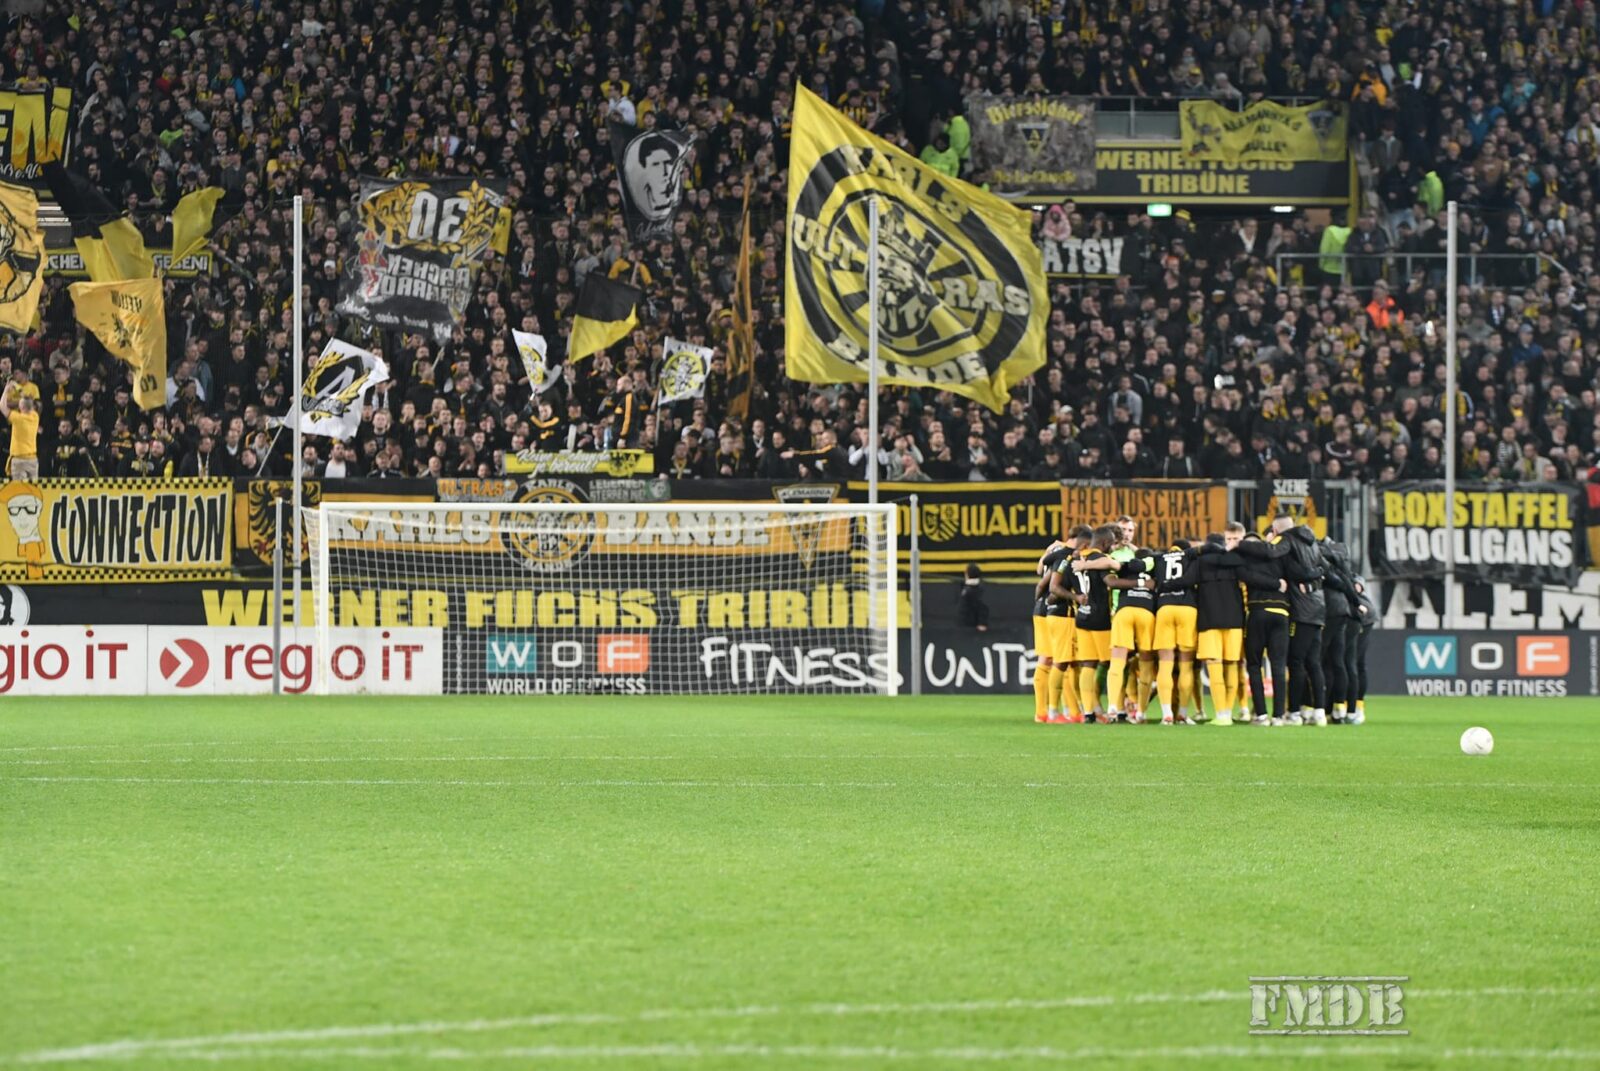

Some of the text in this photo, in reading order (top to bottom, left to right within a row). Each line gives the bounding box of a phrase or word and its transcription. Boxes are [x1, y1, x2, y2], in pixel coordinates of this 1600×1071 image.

[838, 144, 970, 223] KARLS
[1137, 171, 1250, 194] TRIBÜNE
[45, 254, 84, 270] CHE
[1043, 237, 1124, 274] ATSV
[961, 504, 1065, 536] WACHT
[1067, 488, 1211, 518] FREUNDSCHAFT
[1384, 491, 1573, 529] BOXSTAFFEL
[51, 493, 228, 565] CONNECTION
[605, 510, 772, 546] BANDE
[1385, 525, 1574, 568] HOOLIGANS
[1164, 556, 1183, 580] 15
[466, 589, 659, 628] FUCHS
[225, 637, 366, 694] rego
[491, 641, 532, 668] W
[552, 641, 582, 668] O
[607, 641, 642, 669] F
[700, 636, 904, 688] FITNESS
[1410, 642, 1451, 670] W
[1471, 642, 1503, 670] O
[1526, 642, 1561, 671] F
[487, 678, 547, 695] WORLD
[551, 678, 572, 695] OF
[1406, 679, 1567, 697] WORLD OF FITNESS
